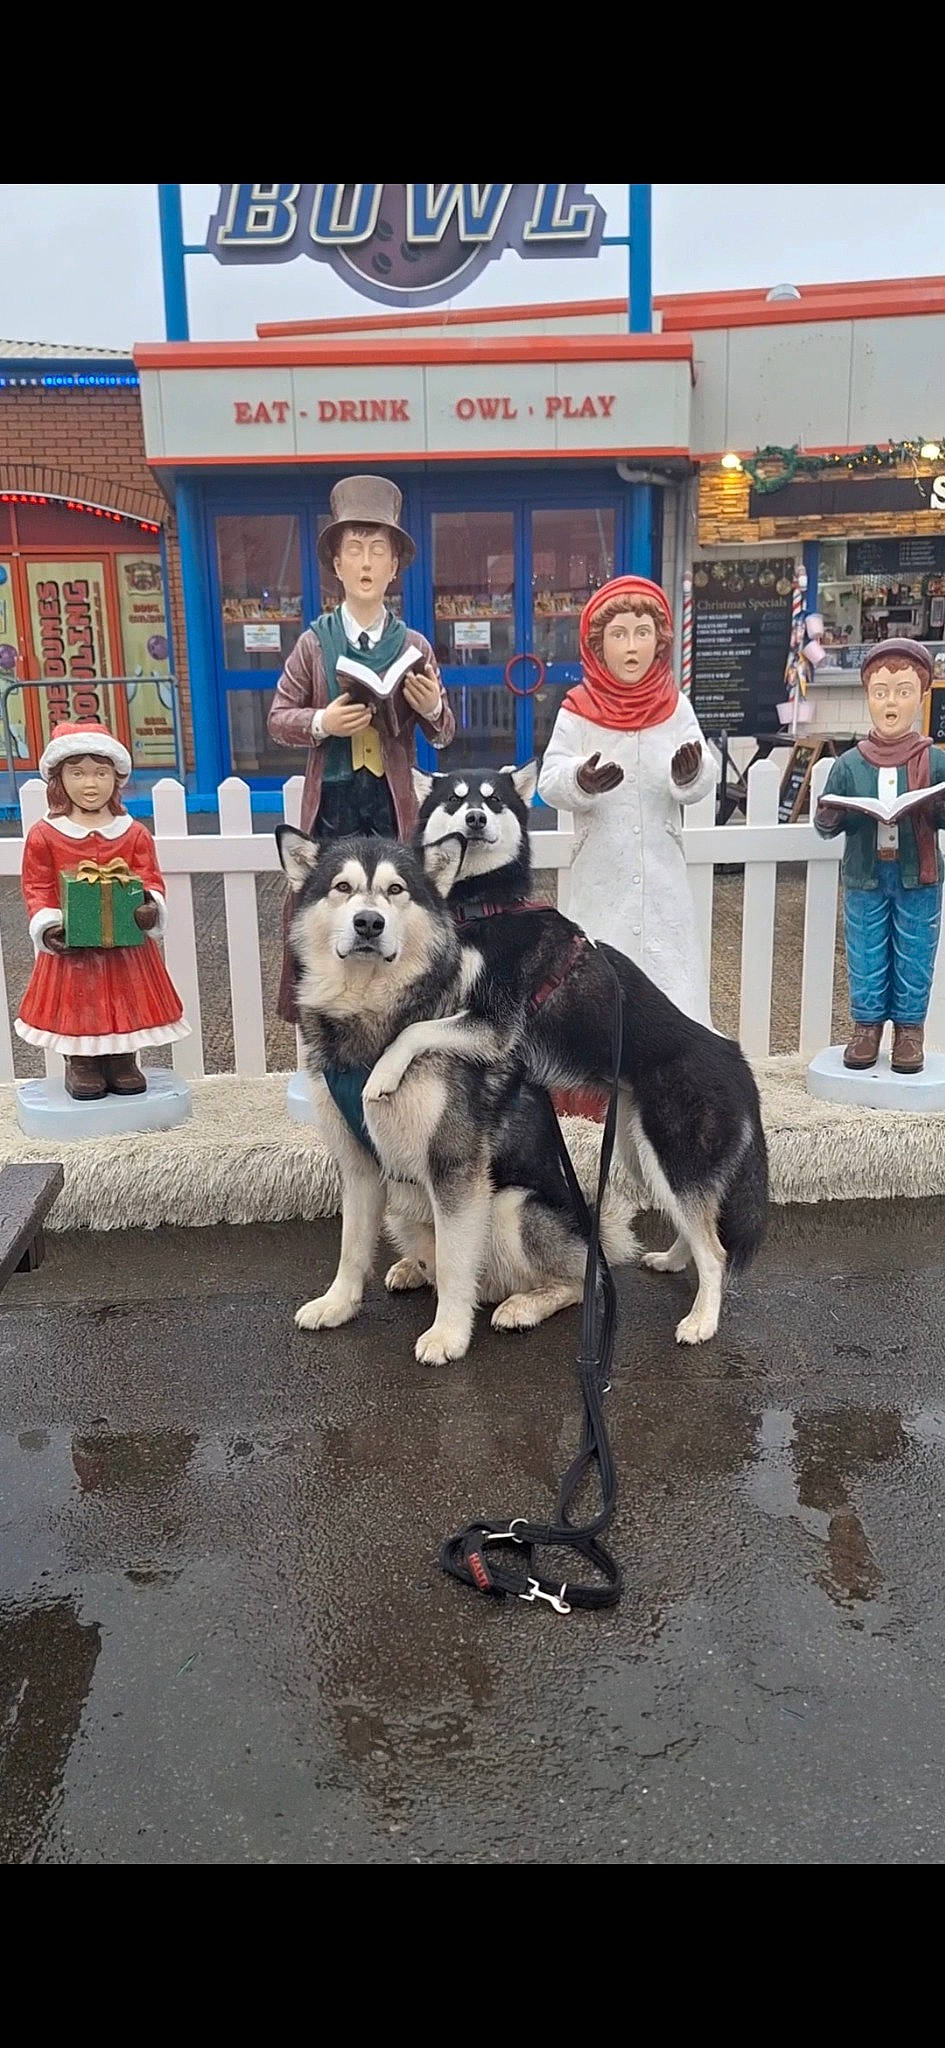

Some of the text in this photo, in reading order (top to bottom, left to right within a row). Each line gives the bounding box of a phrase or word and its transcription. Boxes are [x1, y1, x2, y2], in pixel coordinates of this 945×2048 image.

[234, 401, 289, 424] EAT
[318, 399, 410, 422] DRINK
[456, 398, 518, 420] OWL
[545, 395, 616, 419] PLAY
[697, 597, 787, 611] Christmas Specials
[36, 580, 66, 678] DUNES
